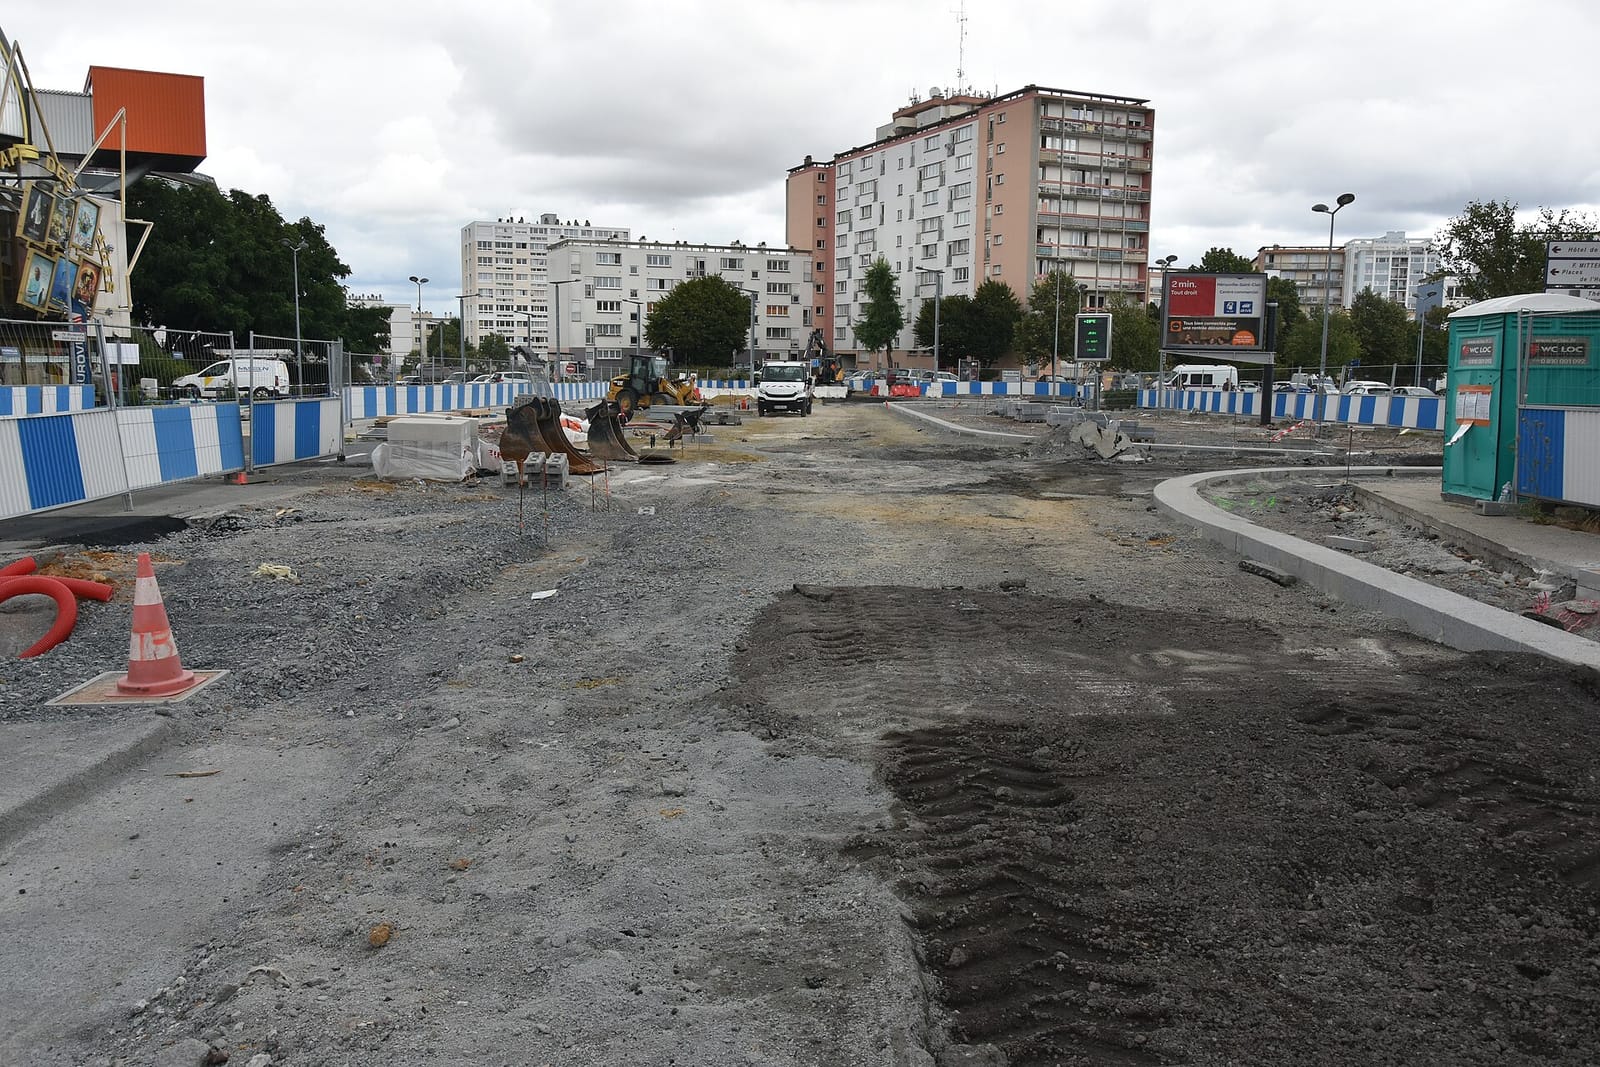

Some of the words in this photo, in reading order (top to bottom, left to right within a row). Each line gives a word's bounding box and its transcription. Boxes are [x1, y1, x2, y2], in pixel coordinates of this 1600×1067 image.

[1171, 280, 1177, 288] 2
[1178, 280, 1197, 288] min.
[75, 341, 86, 384] UROVI
